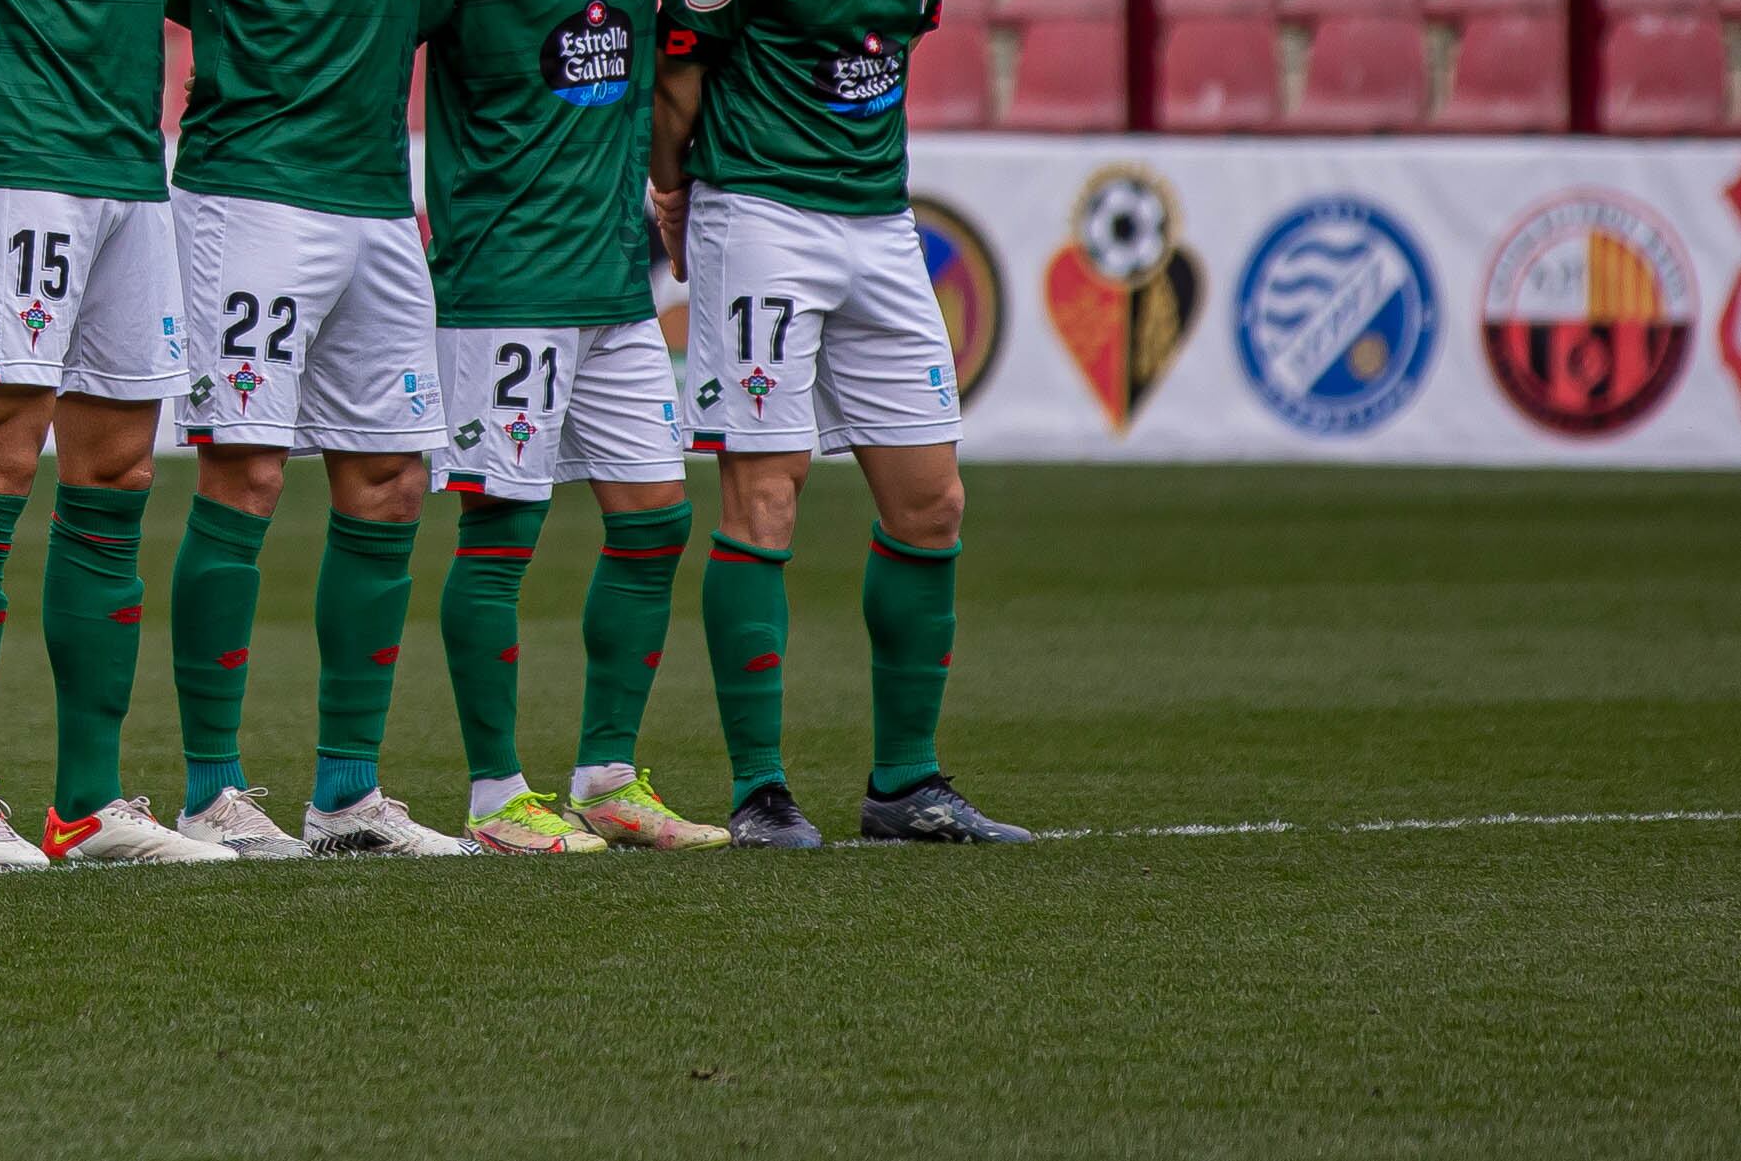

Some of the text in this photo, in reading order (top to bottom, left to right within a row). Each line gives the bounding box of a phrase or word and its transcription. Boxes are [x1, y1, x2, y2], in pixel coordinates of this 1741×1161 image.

[560, 26, 628, 57] Estrella
[565, 52, 626, 82] Galicia
[9, 229, 71, 301] 15
[220, 290, 298, 365] 22
[729, 296, 795, 364] 17
[493, 342, 558, 413] 21
